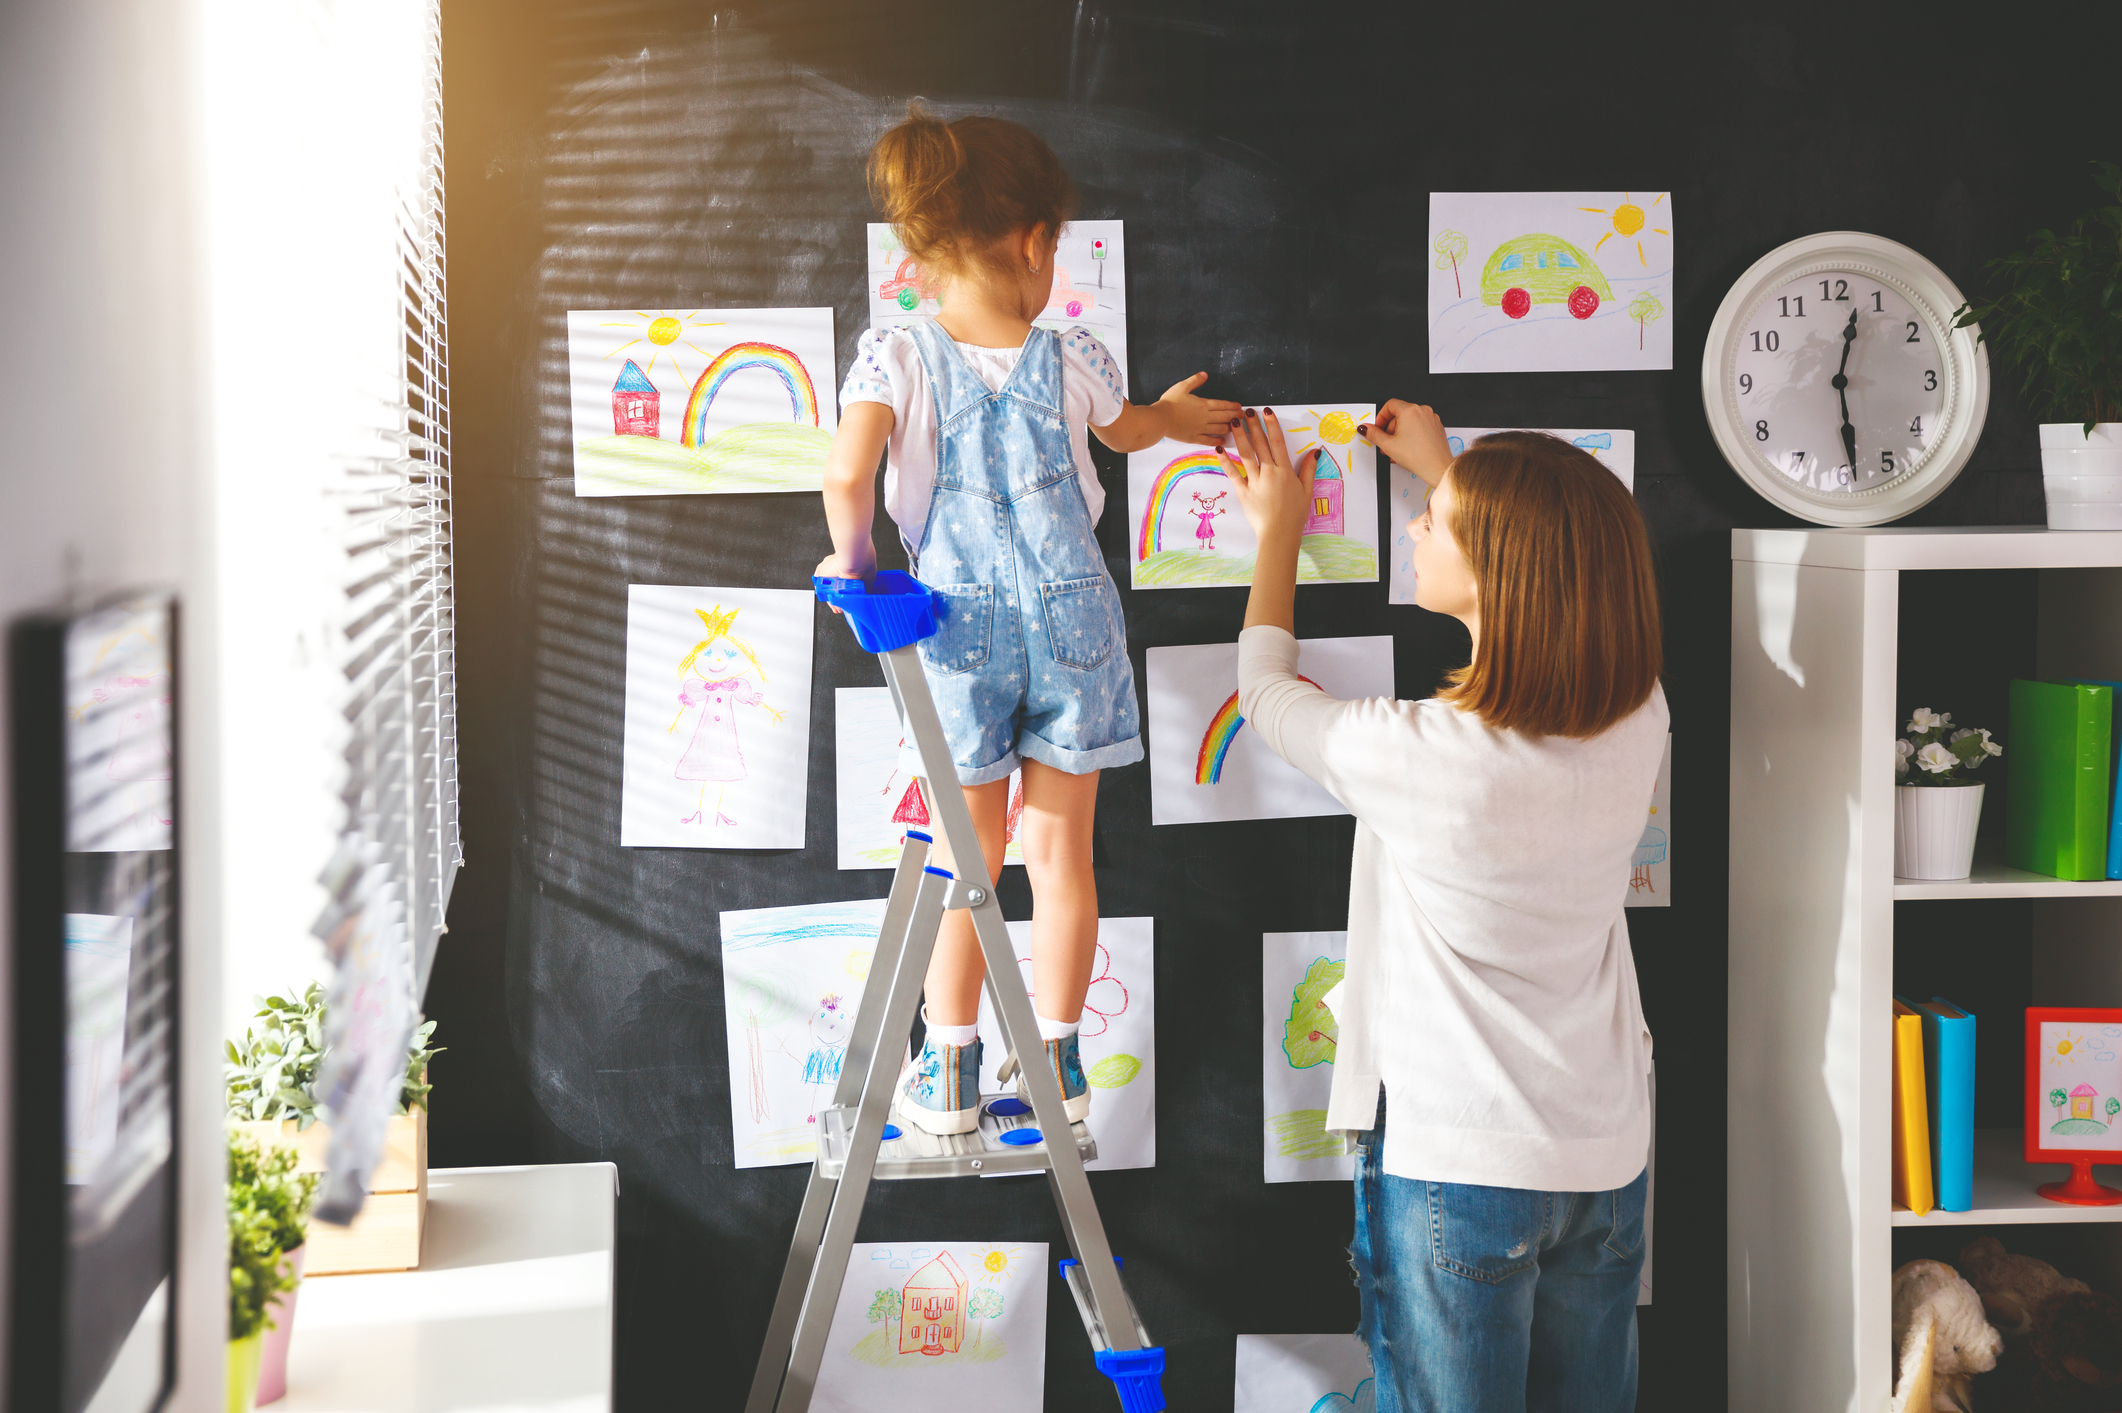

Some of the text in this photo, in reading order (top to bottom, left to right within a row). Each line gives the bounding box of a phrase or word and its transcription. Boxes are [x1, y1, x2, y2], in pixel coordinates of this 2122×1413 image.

[1818, 279, 1849, 301] 12
[1777, 296, 1807, 318] 11
[1871, 291, 1885, 312] 1
[1750, 330, 1780, 352] 10
[1906, 321, 1920, 343] 2
[1739, 373, 1753, 395] 9
[1923, 370, 1938, 391] 3
[1755, 420, 1769, 441] 8
[1909, 416, 1924, 437] 4
[1791, 451, 1805, 473] 7
[1880, 451, 1895, 473] 5
[1836, 464, 1850, 486] 6
